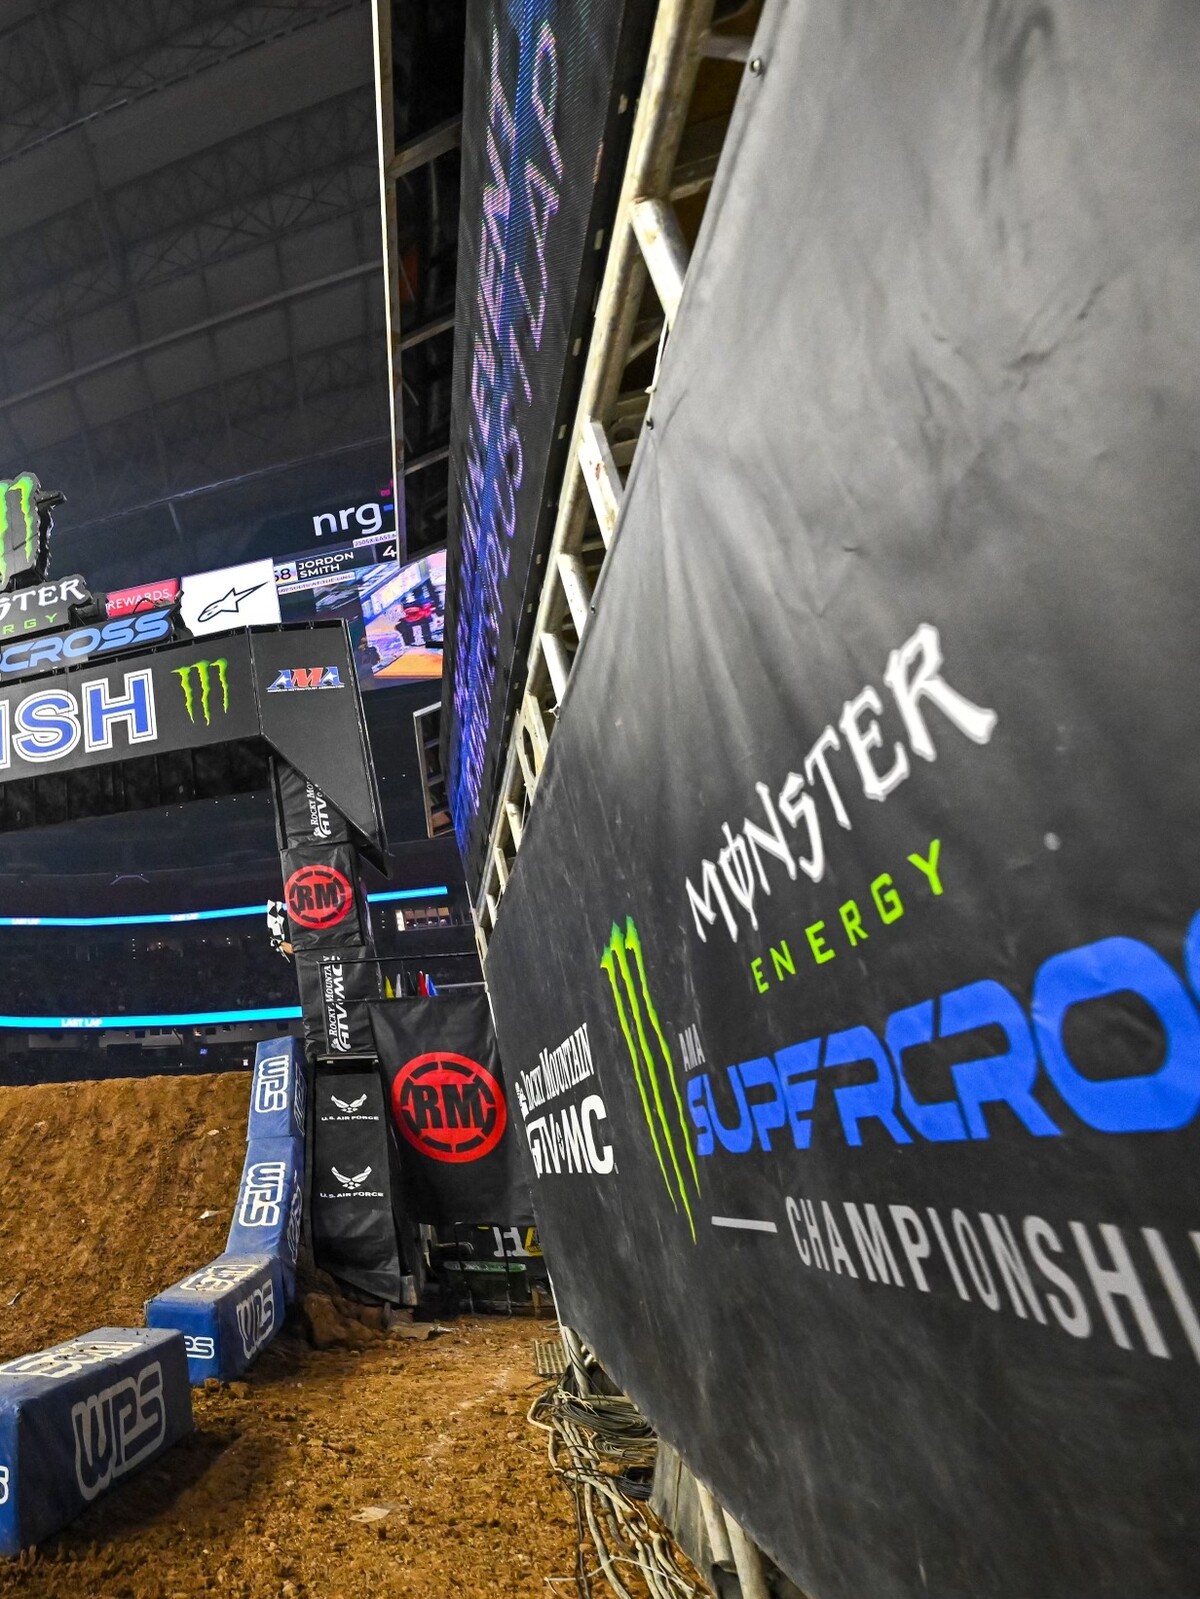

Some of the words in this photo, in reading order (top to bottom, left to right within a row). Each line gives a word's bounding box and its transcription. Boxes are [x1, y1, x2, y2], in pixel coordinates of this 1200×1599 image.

[515, 19, 564, 351] LAP
[471, 20, 517, 446] EVENT
[313, 502, 383, 537] nrg
[298, 551, 354, 570] JORDON
[300, 564, 340, 579] SMITH
[266, 666, 344, 689] AMA
[684, 622, 998, 946] MONSTER
[308, 800, 319, 826] ROCKY
[297, 884, 338, 910] RM
[749, 837, 945, 996] ENERGY
[327, 1006, 338, 1037] ROCKY
[678, 1023, 707, 1073] AMA
[687, 908, 1200, 1156] SUPERCRO
[255, 1055, 289, 1113] WPS
[538, 1022, 595, 1101] MOUNTAIN
[413, 1083, 488, 1130] RM
[239, 1162, 287, 1227] WPS
[786, 1197, 1200, 1366] CHAMPIONSHI
[185, 1336, 214, 1359] PS
[71, 1361, 167, 1500] WPS
